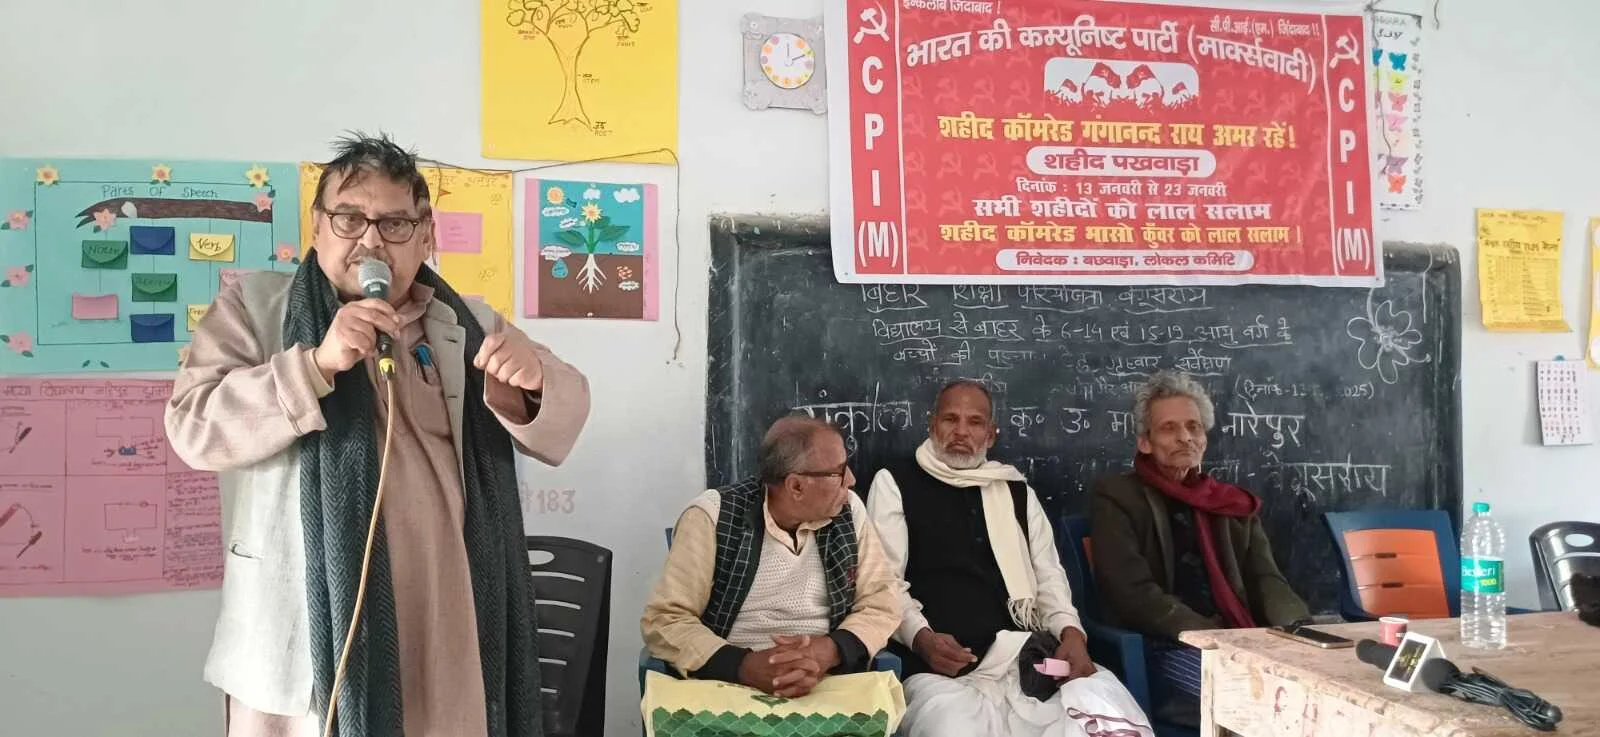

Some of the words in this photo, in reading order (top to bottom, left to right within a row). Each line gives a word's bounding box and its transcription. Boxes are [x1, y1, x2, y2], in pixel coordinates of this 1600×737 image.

[907, 32, 971, 67] भारत
[978, 18, 1012, 52] की
[1131, 20, 1178, 53] पार्टी
[1187, 24, 1316, 95] (मार्क्सवादी)
[937, 111, 994, 140] शहीद
[1001, 112, 1074, 143] कॉमरेड
[1081, 114, 1162, 145] गंगानन्द
[1169, 123, 1204, 146] राय
[1212, 125, 1256, 147] अमर
[1044, 148, 1106, 171] शहीद
[1112, 155, 1199, 176] पखवाड़ा
[1016, 177, 1057, 194] दिनांक
[1076, 182, 1092, 195] 13
[1099, 180, 1141, 197] जनवरी
[1148, 180, 1160, 196] से
[1163, 184, 1182, 197] 23
[1187, 181, 1227, 198] जनवरी
[973, 195, 1022, 218] सभी
[1030, 198, 1100, 219] शहीदों
[1107, 198, 1137, 220] को
[1147, 203, 1196, 221] लाल
[1203, 202, 1273, 221] सलाम
[197, 238, 222, 251] Verb
[939, 220, 998, 243] शहीद
[1004, 221, 1077, 243] कॉमरेड
[1180, 222, 1201, 243] को
[1207, 227, 1241, 243] लाल
[1247, 226, 1290, 244] सलाम
[1016, 251, 1069, 266] निवेदक
[1143, 252, 1190, 266] लोकल
[872, 319, 941, 338] विद्यालय
[949, 312, 968, 335] से
